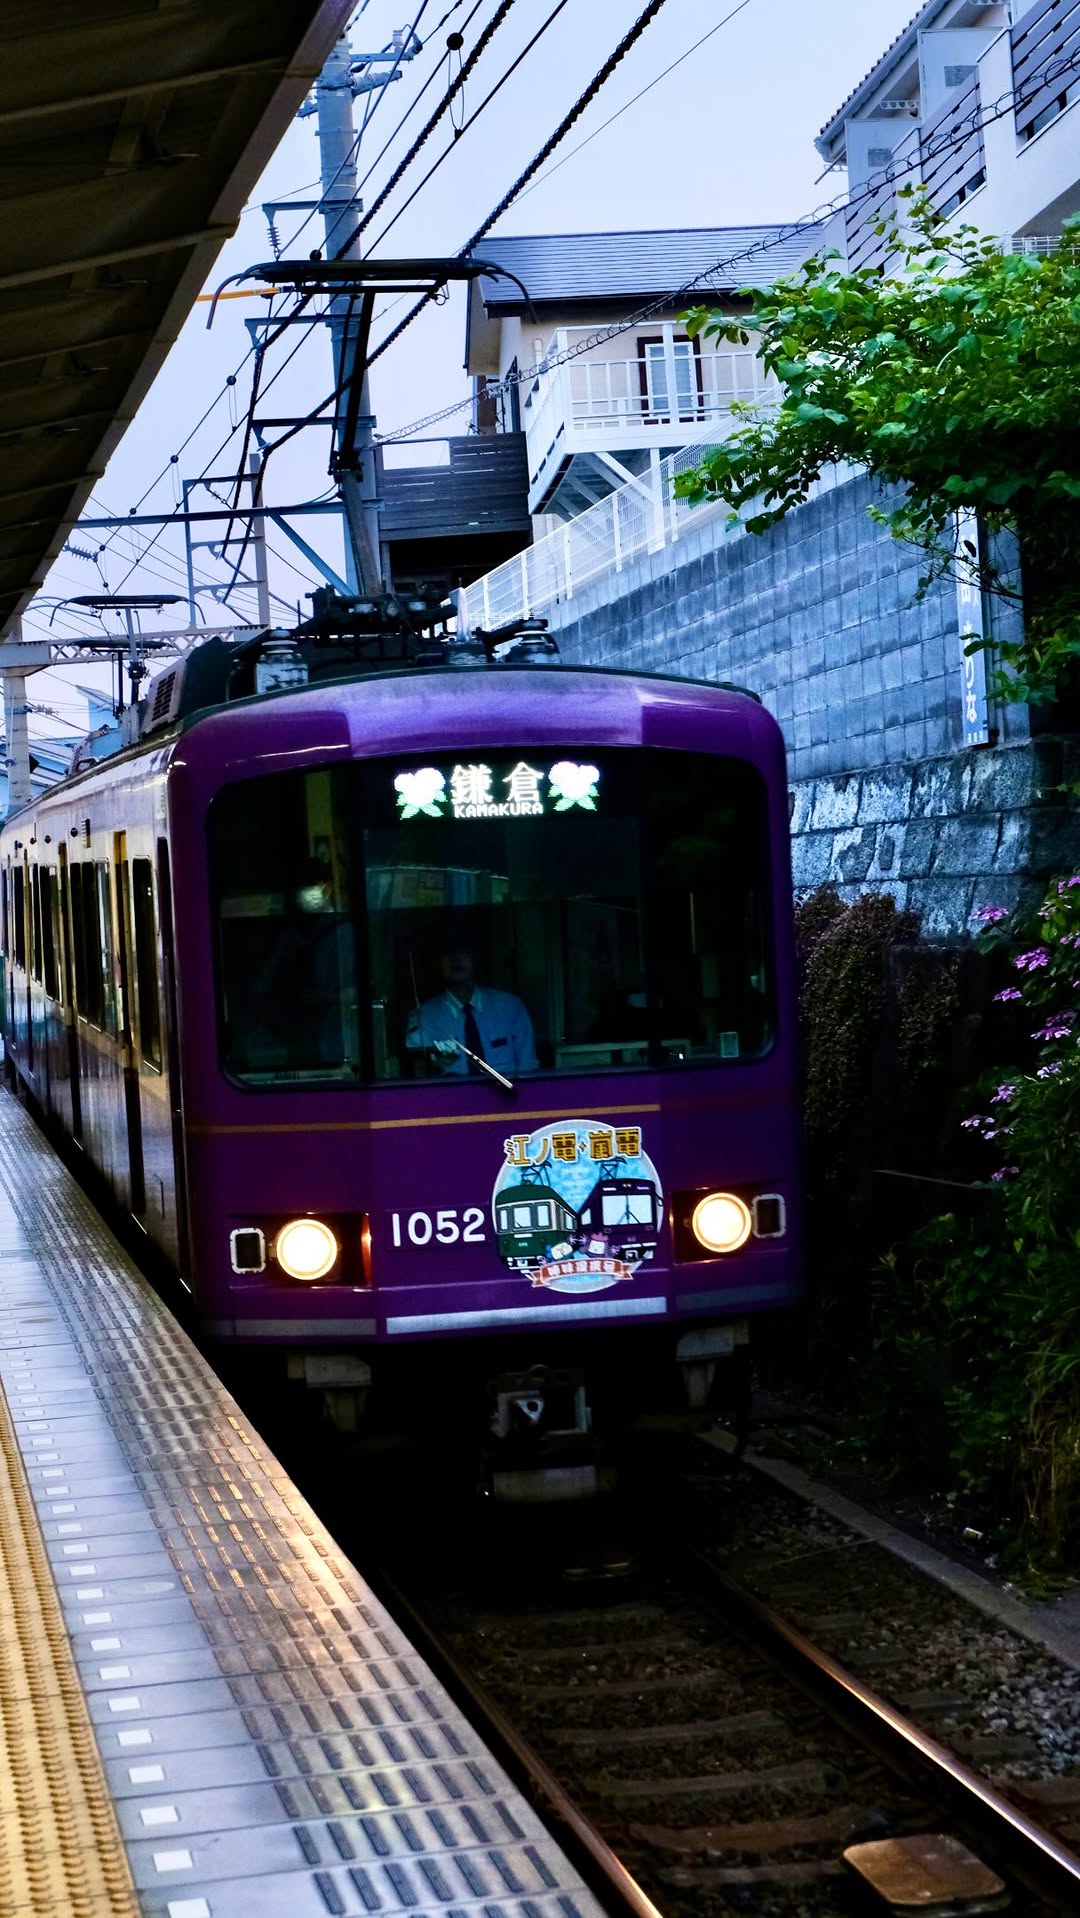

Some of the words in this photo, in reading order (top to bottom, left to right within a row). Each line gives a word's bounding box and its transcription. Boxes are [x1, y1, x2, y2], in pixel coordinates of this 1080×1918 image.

[450, 761, 545, 805] 鎌倉
[454, 801, 544, 819] KAMAKURA
[392, 1207, 486, 1248] 1052
